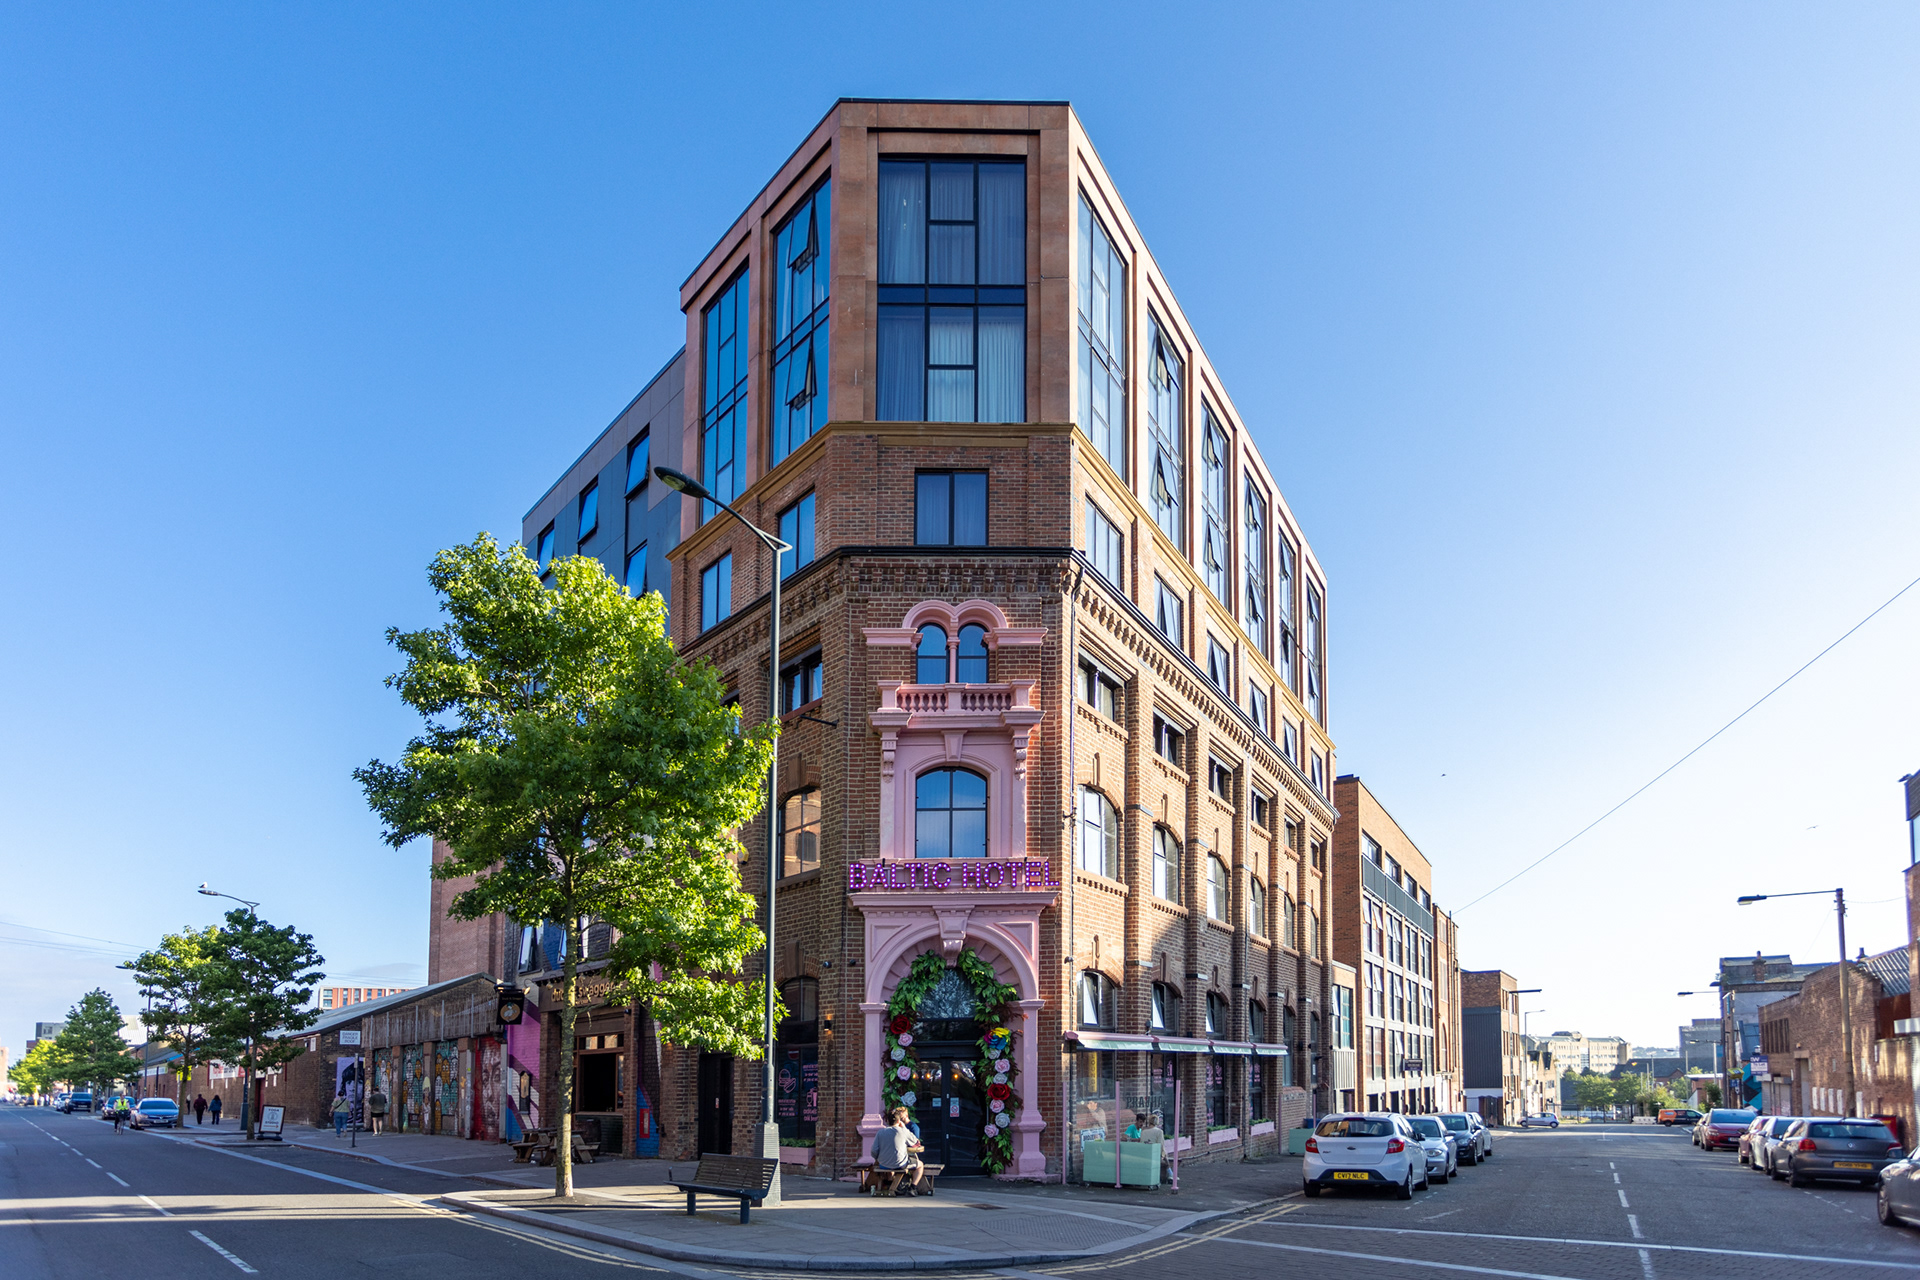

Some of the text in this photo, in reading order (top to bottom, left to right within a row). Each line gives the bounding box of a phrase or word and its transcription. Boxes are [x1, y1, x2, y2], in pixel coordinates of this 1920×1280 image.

[849, 861, 1060, 889] BALTIC HOTEL
[1126, 1096, 1164, 1108] PRAVHA
